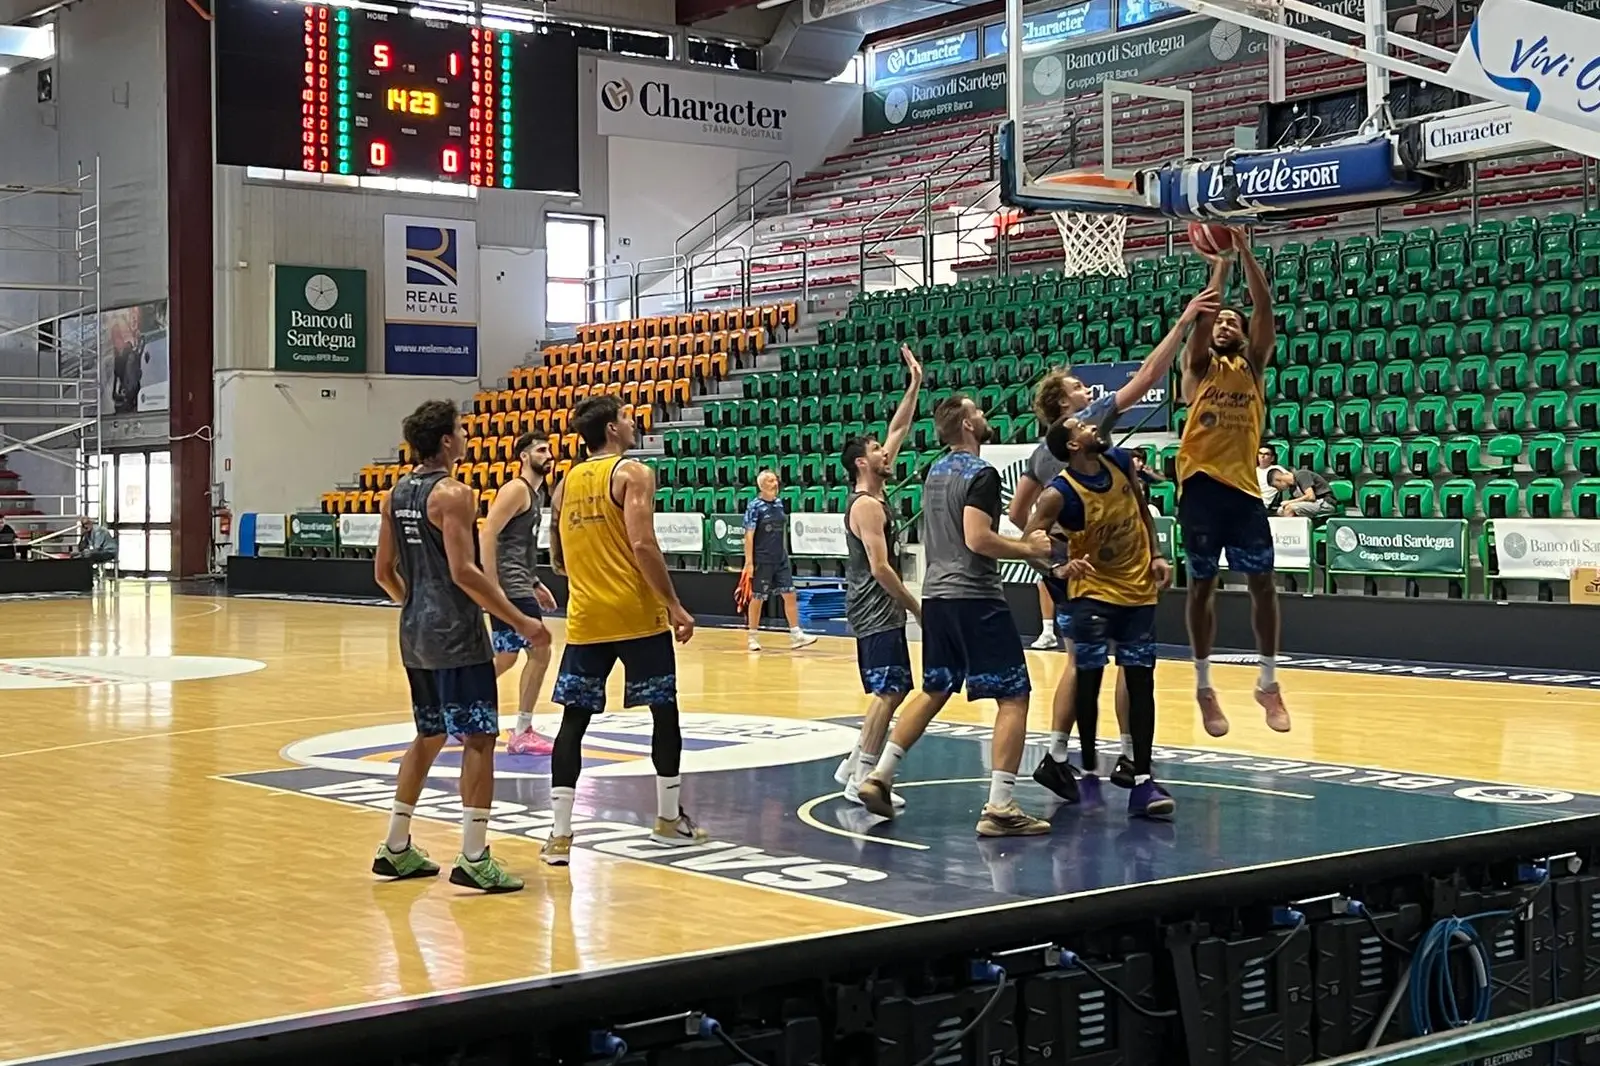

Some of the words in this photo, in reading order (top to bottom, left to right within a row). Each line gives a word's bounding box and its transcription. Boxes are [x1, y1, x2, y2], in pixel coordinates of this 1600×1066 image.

[366, 13, 388, 21] HOME
[425, 20, 448, 29] GUEST
[374, 44, 389, 68] 5
[906, 44, 961, 66] Character
[1066, 50, 1106, 70] Banco
[1108, 44, 1119, 62] di
[1122, 34, 1185, 60] Sardegna
[1510, 36, 1574, 77] Vivi
[911, 84, 946, 102] Banco
[946, 78, 957, 94] di
[958, 71, 1007, 92] Sardegn
[1066, 76, 1094, 90] Gruppo
[1116, 68, 1138, 80] Banca
[640, 81, 786, 130] Character
[912, 108, 936, 120] Gruppo
[936, 102, 952, 115] BPER
[954, 100, 973, 112] Banca
[702, 124, 740, 136] STAMPA
[741, 126, 782, 140] DIGITALE
[1430, 121, 1512, 148] Character
[370, 142, 386, 166] 0
[442, 149, 457, 172] 0
[1208, 158, 1292, 198] brtelè
[1292, 165, 1340, 189] SPORT
[406, 290, 458, 304] REALE
[406, 304, 458, 314] MUTUA
[291, 310, 338, 329] Banco
[340, 313, 352, 329] di
[287, 330, 356, 350] Sardegna
[394, 344, 468, 354] www.realemutua.it
[1358, 533, 1392, 547] Banco
[1392, 534, 1402, 548] di
[1404, 534, 1454, 550] Sardegna
[1530, 539, 1568, 552] Banco
[1570, 539, 1580, 552] di
[1360, 550, 1383, 561] Gruppo
[1384, 552, 1400, 560] BPER
[1400, 553, 1420, 561] Banca
[1231, 759, 1455, 790] BLUE
[1484, 1046, 1533, 1066] ELECTRONICS
